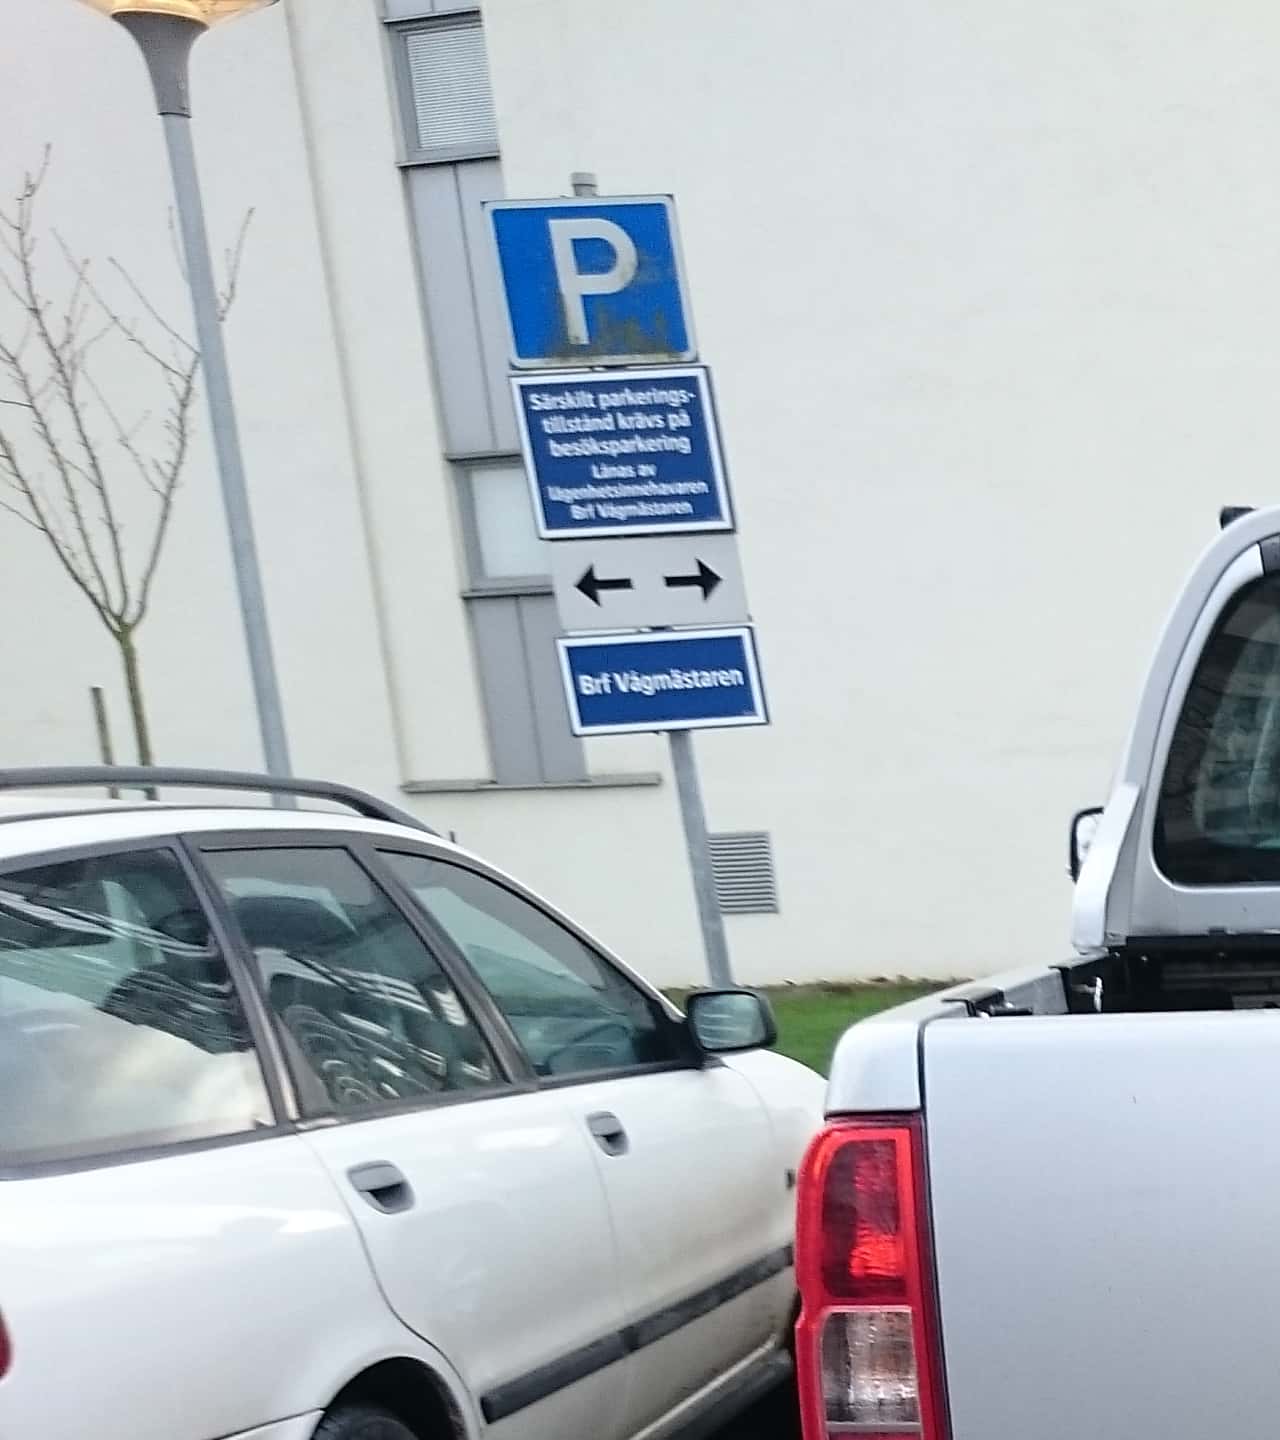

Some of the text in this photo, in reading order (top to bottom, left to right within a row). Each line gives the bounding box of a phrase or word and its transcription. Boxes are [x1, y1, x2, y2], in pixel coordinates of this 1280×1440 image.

[548, 217, 638, 345] P
[529, 387, 696, 411] Särskilt parkerings-
[541, 409, 692, 434] tillstånd krävs på
[548, 435, 692, 458] besöksparkering
[569, 503, 596, 520] Brf
[577, 667, 745, 697] Brf Vägmästaren
